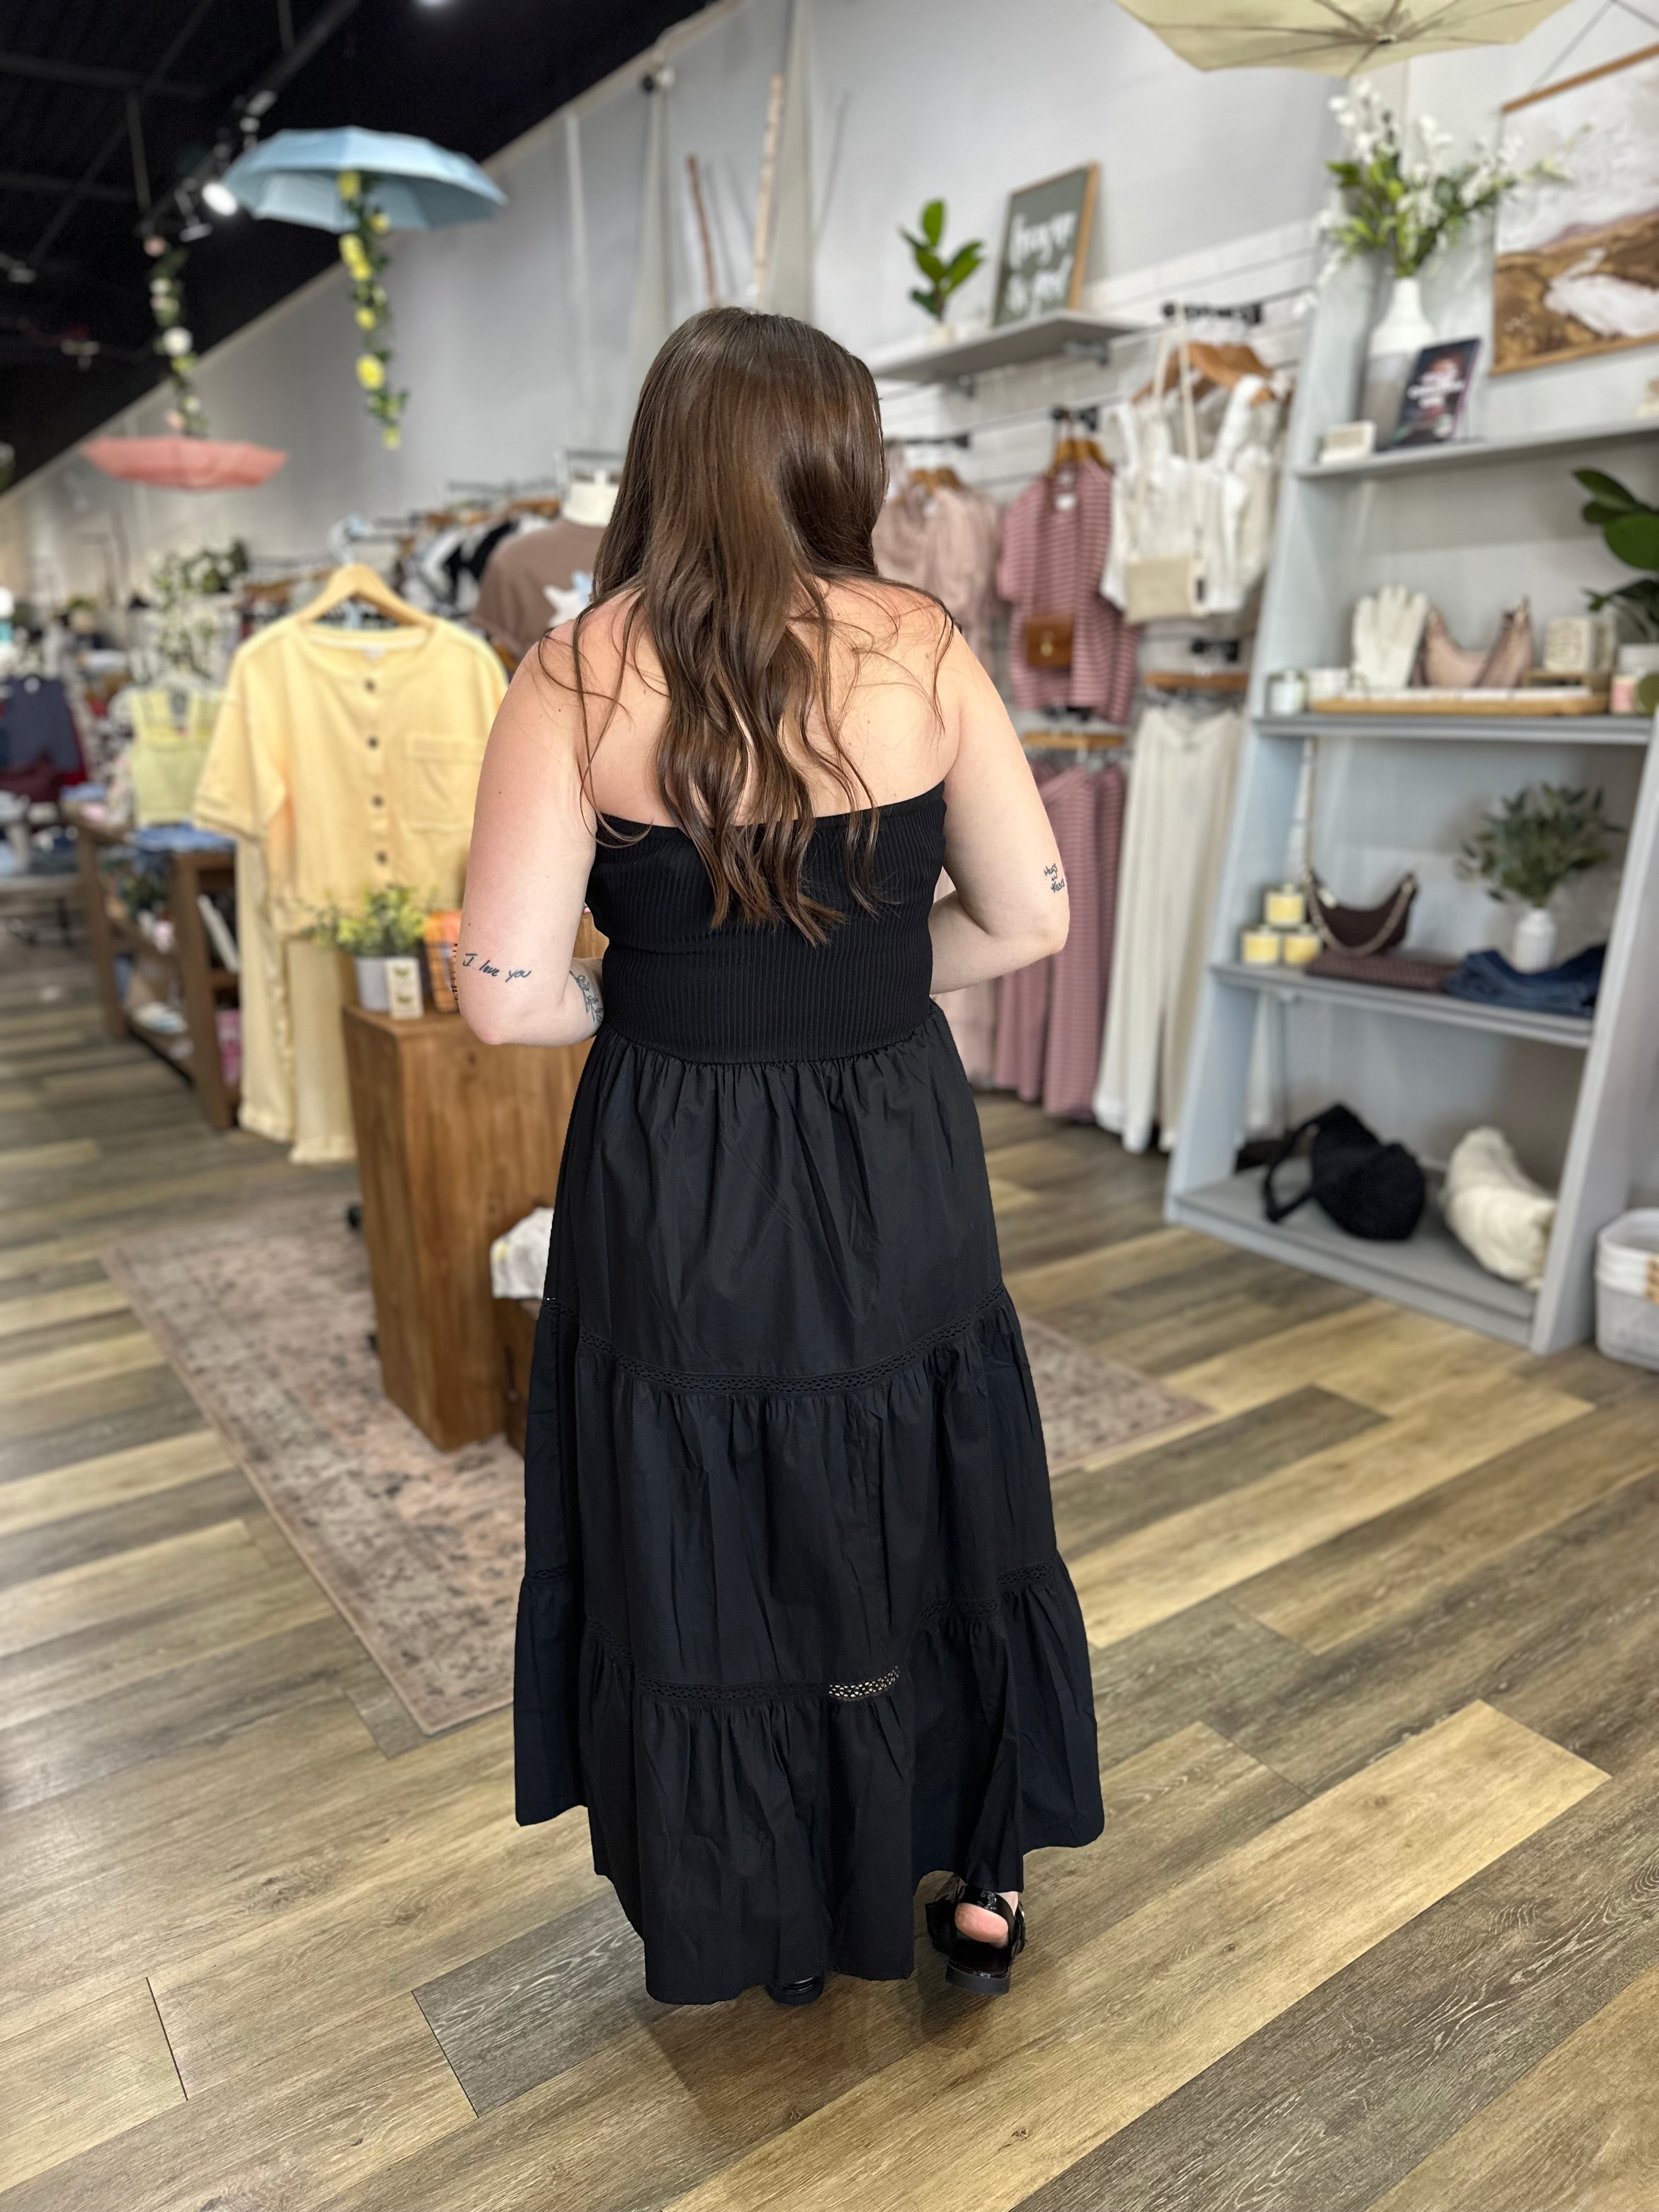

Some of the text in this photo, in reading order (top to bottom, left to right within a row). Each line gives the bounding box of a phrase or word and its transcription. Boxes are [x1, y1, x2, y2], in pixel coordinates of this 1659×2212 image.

[462, 953, 532, 983] I love you
